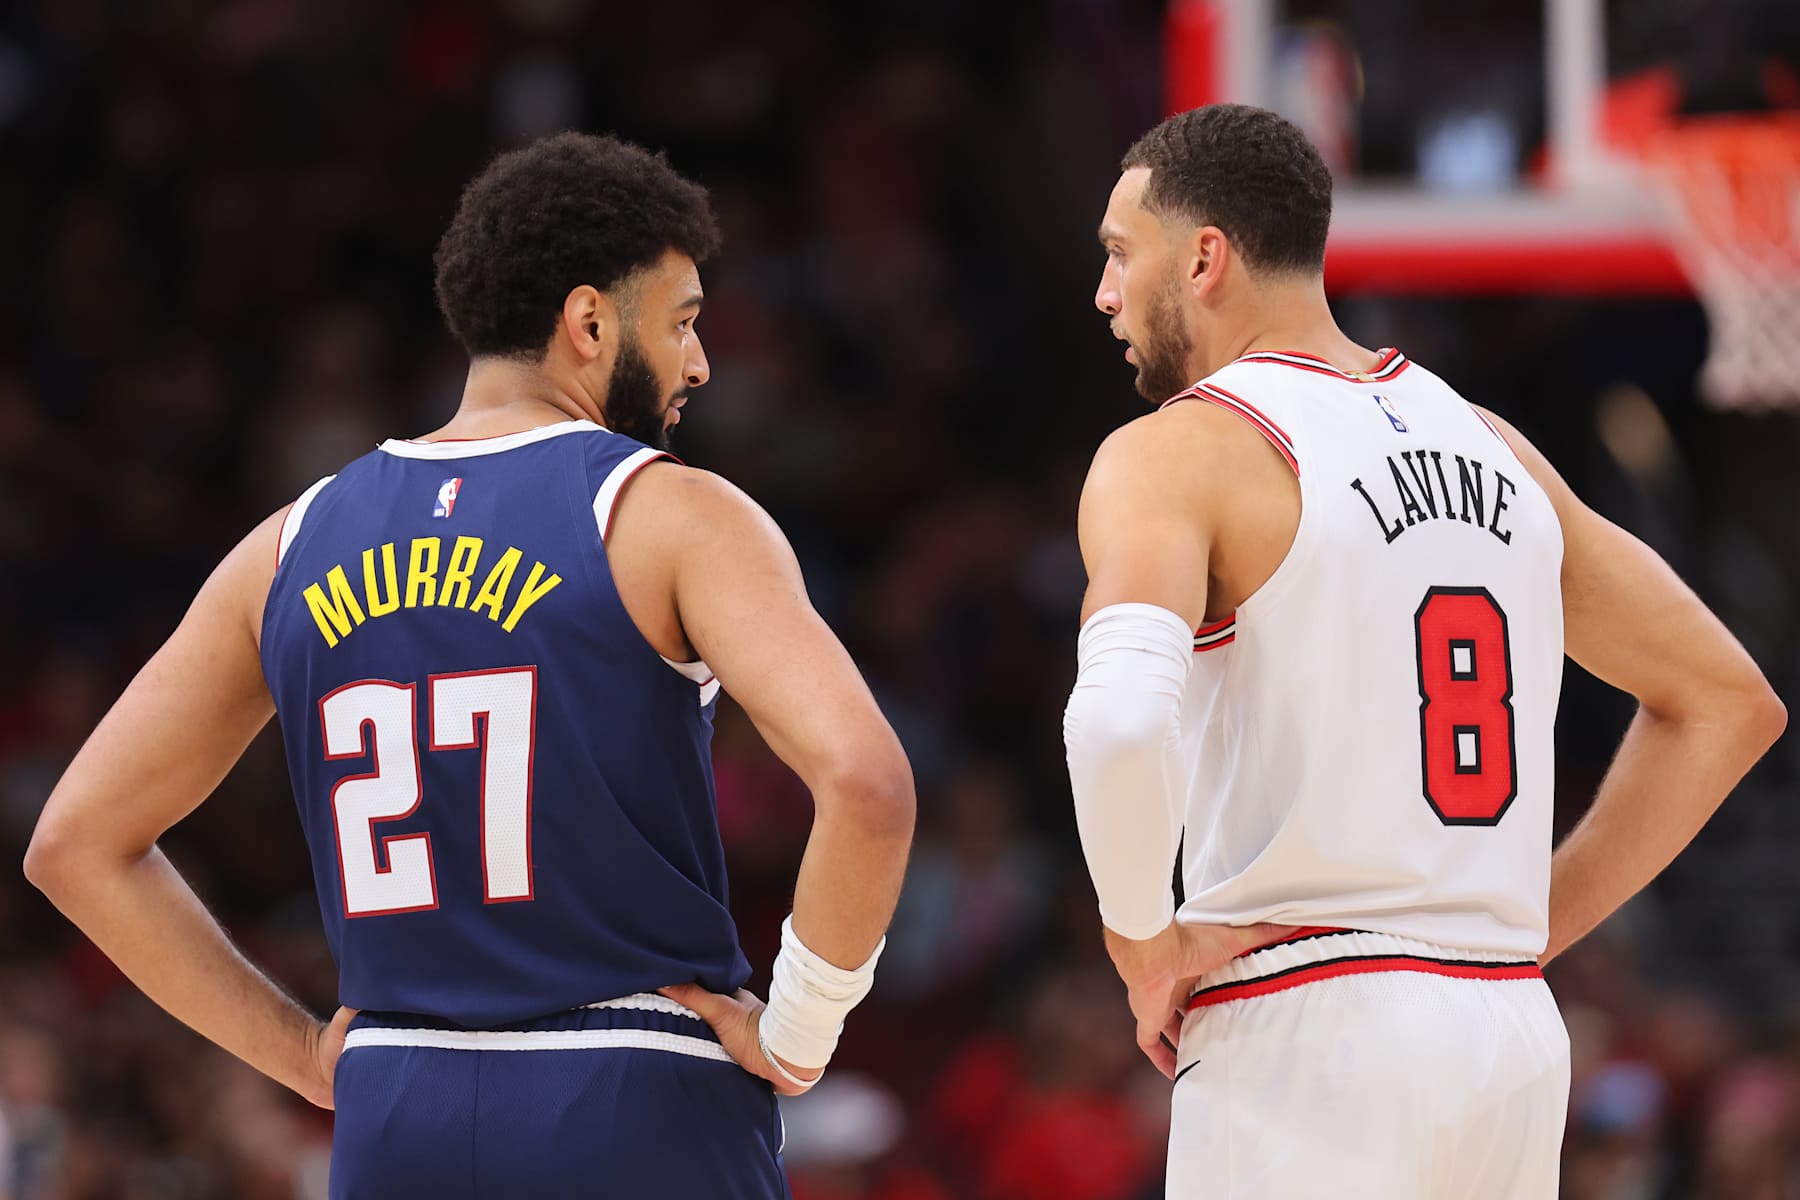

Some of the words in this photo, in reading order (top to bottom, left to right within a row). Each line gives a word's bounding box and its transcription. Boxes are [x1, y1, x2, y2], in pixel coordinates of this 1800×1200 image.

[1351, 449, 1516, 546] LAVINE
[303, 536, 562, 648] MURRAY
[318, 665, 537, 918] 27
[1414, 585, 1517, 826] 8
